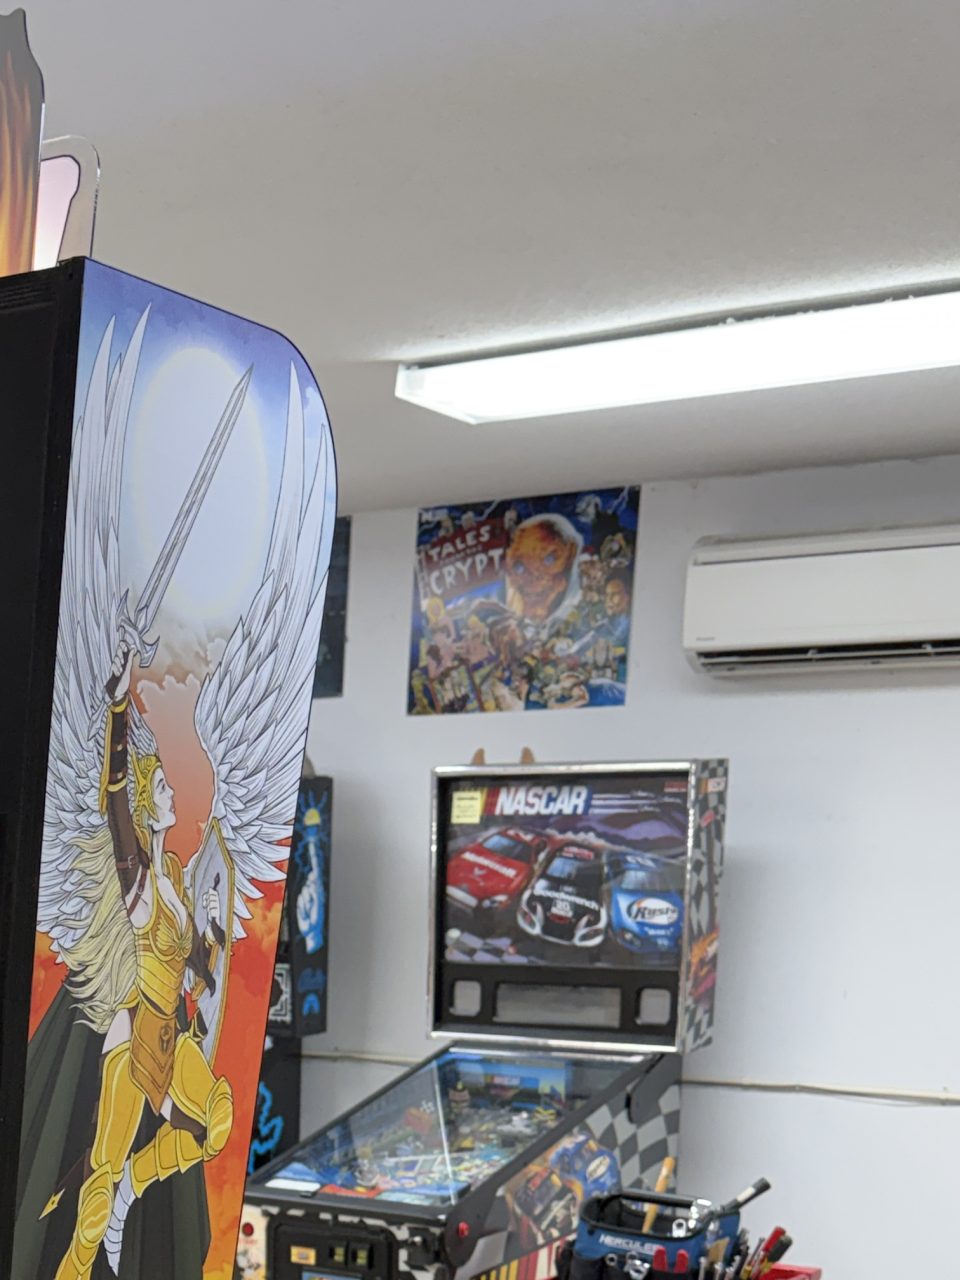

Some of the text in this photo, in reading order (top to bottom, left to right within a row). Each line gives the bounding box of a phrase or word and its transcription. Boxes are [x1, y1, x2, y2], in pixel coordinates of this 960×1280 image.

[427, 525, 491, 562] TALES
[430, 548, 504, 594] CRYPT
[495, 785, 588, 816] NASCAR
